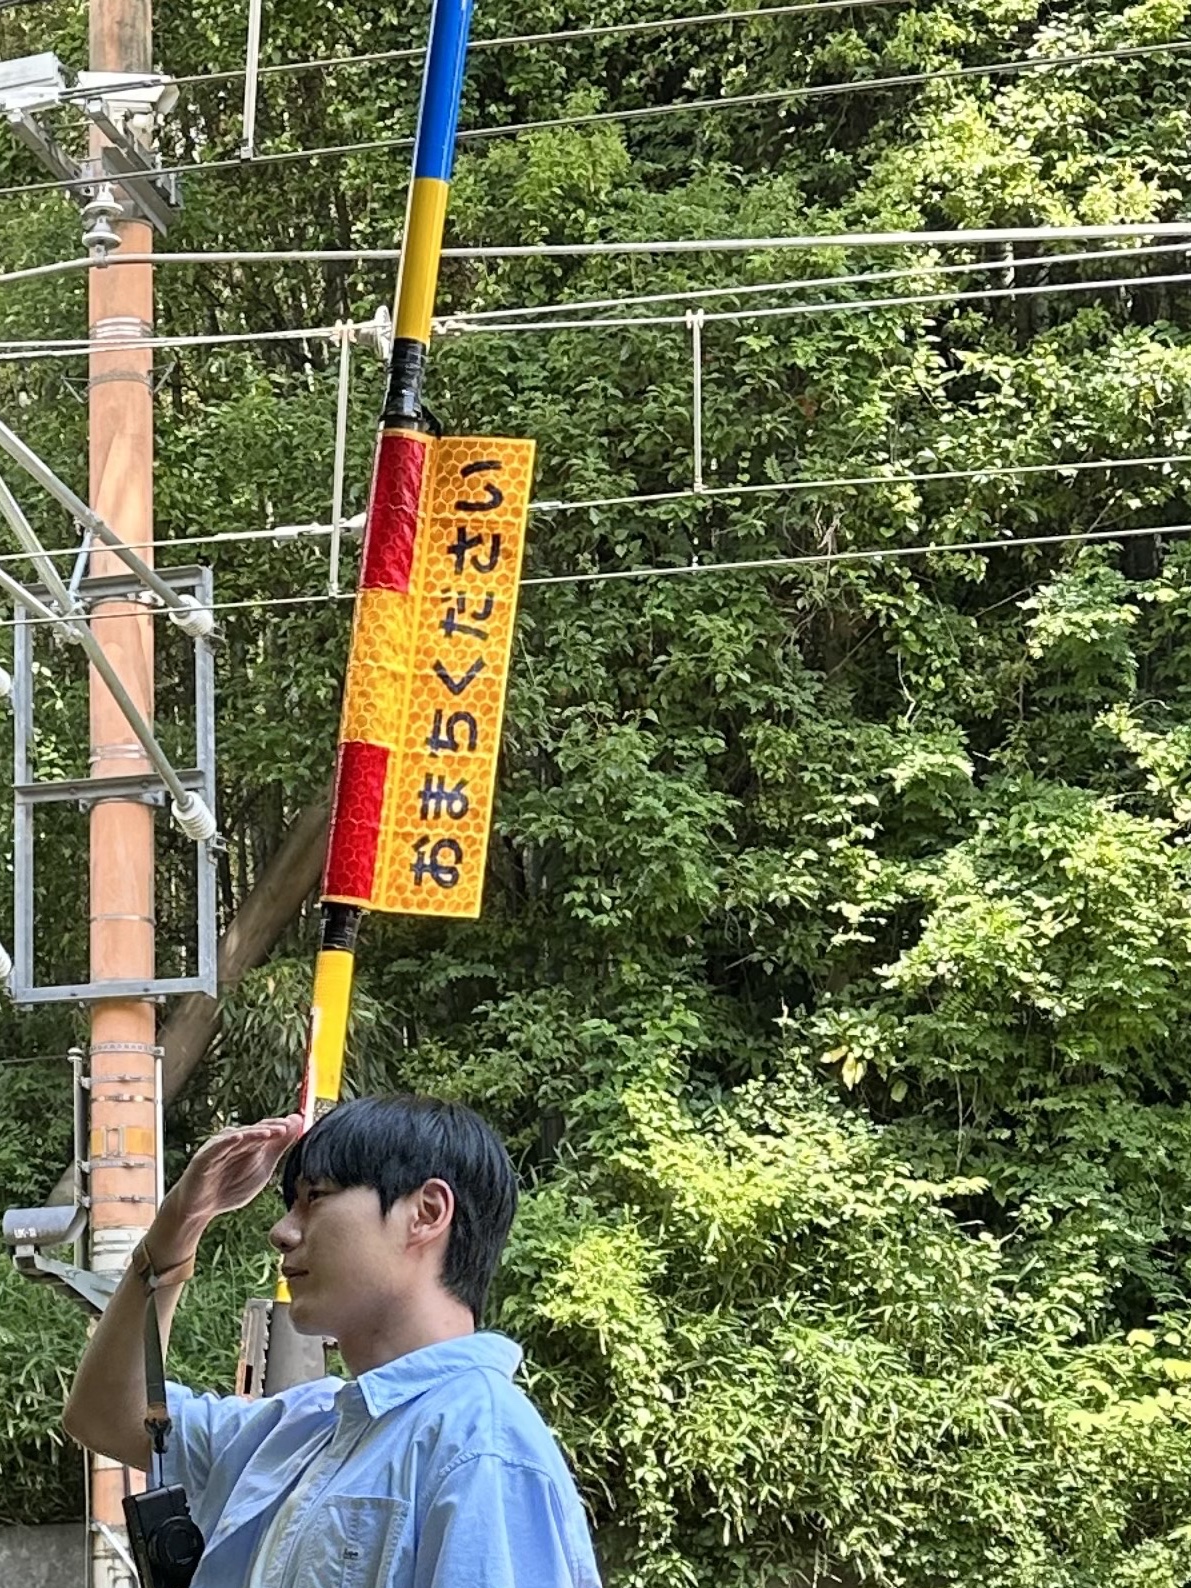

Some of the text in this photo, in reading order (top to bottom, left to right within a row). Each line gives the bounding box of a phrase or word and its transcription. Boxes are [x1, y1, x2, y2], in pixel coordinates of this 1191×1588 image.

[408, 459, 505, 891] おまちください
